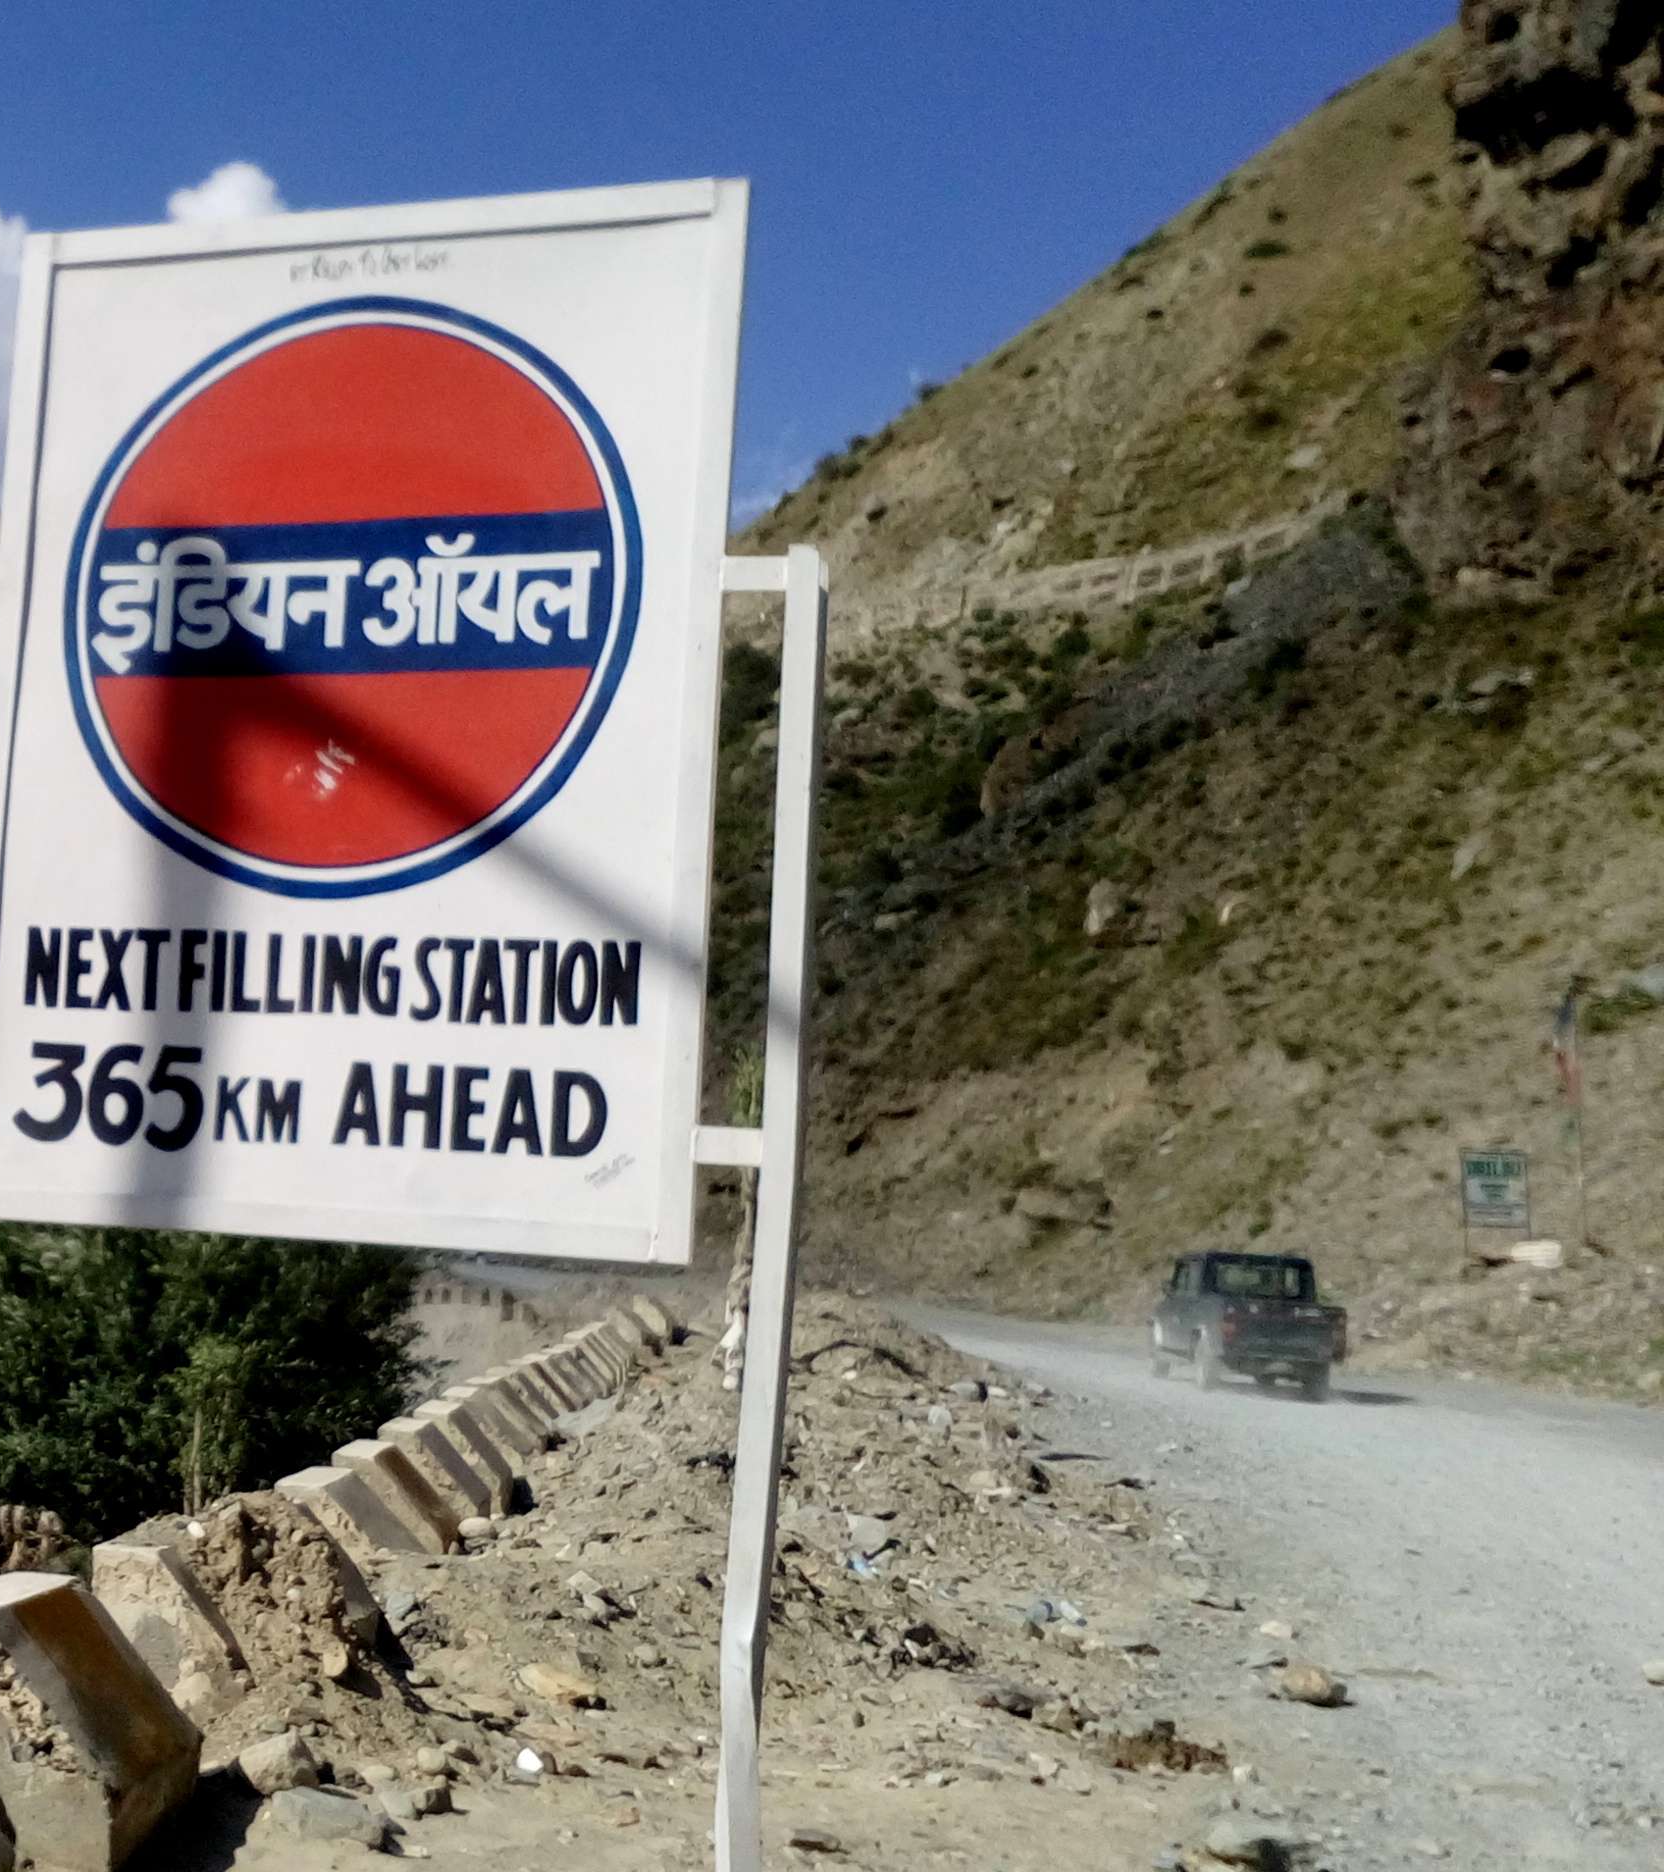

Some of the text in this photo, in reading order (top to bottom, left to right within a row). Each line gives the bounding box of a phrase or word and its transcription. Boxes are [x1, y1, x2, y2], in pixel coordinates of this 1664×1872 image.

[91, 533, 601, 674] इंडियन ऑयल
[24, 926, 642, 1026] NEXT FILLING STATION
[13, 1041, 609, 1158] 365 KM AHEAD
